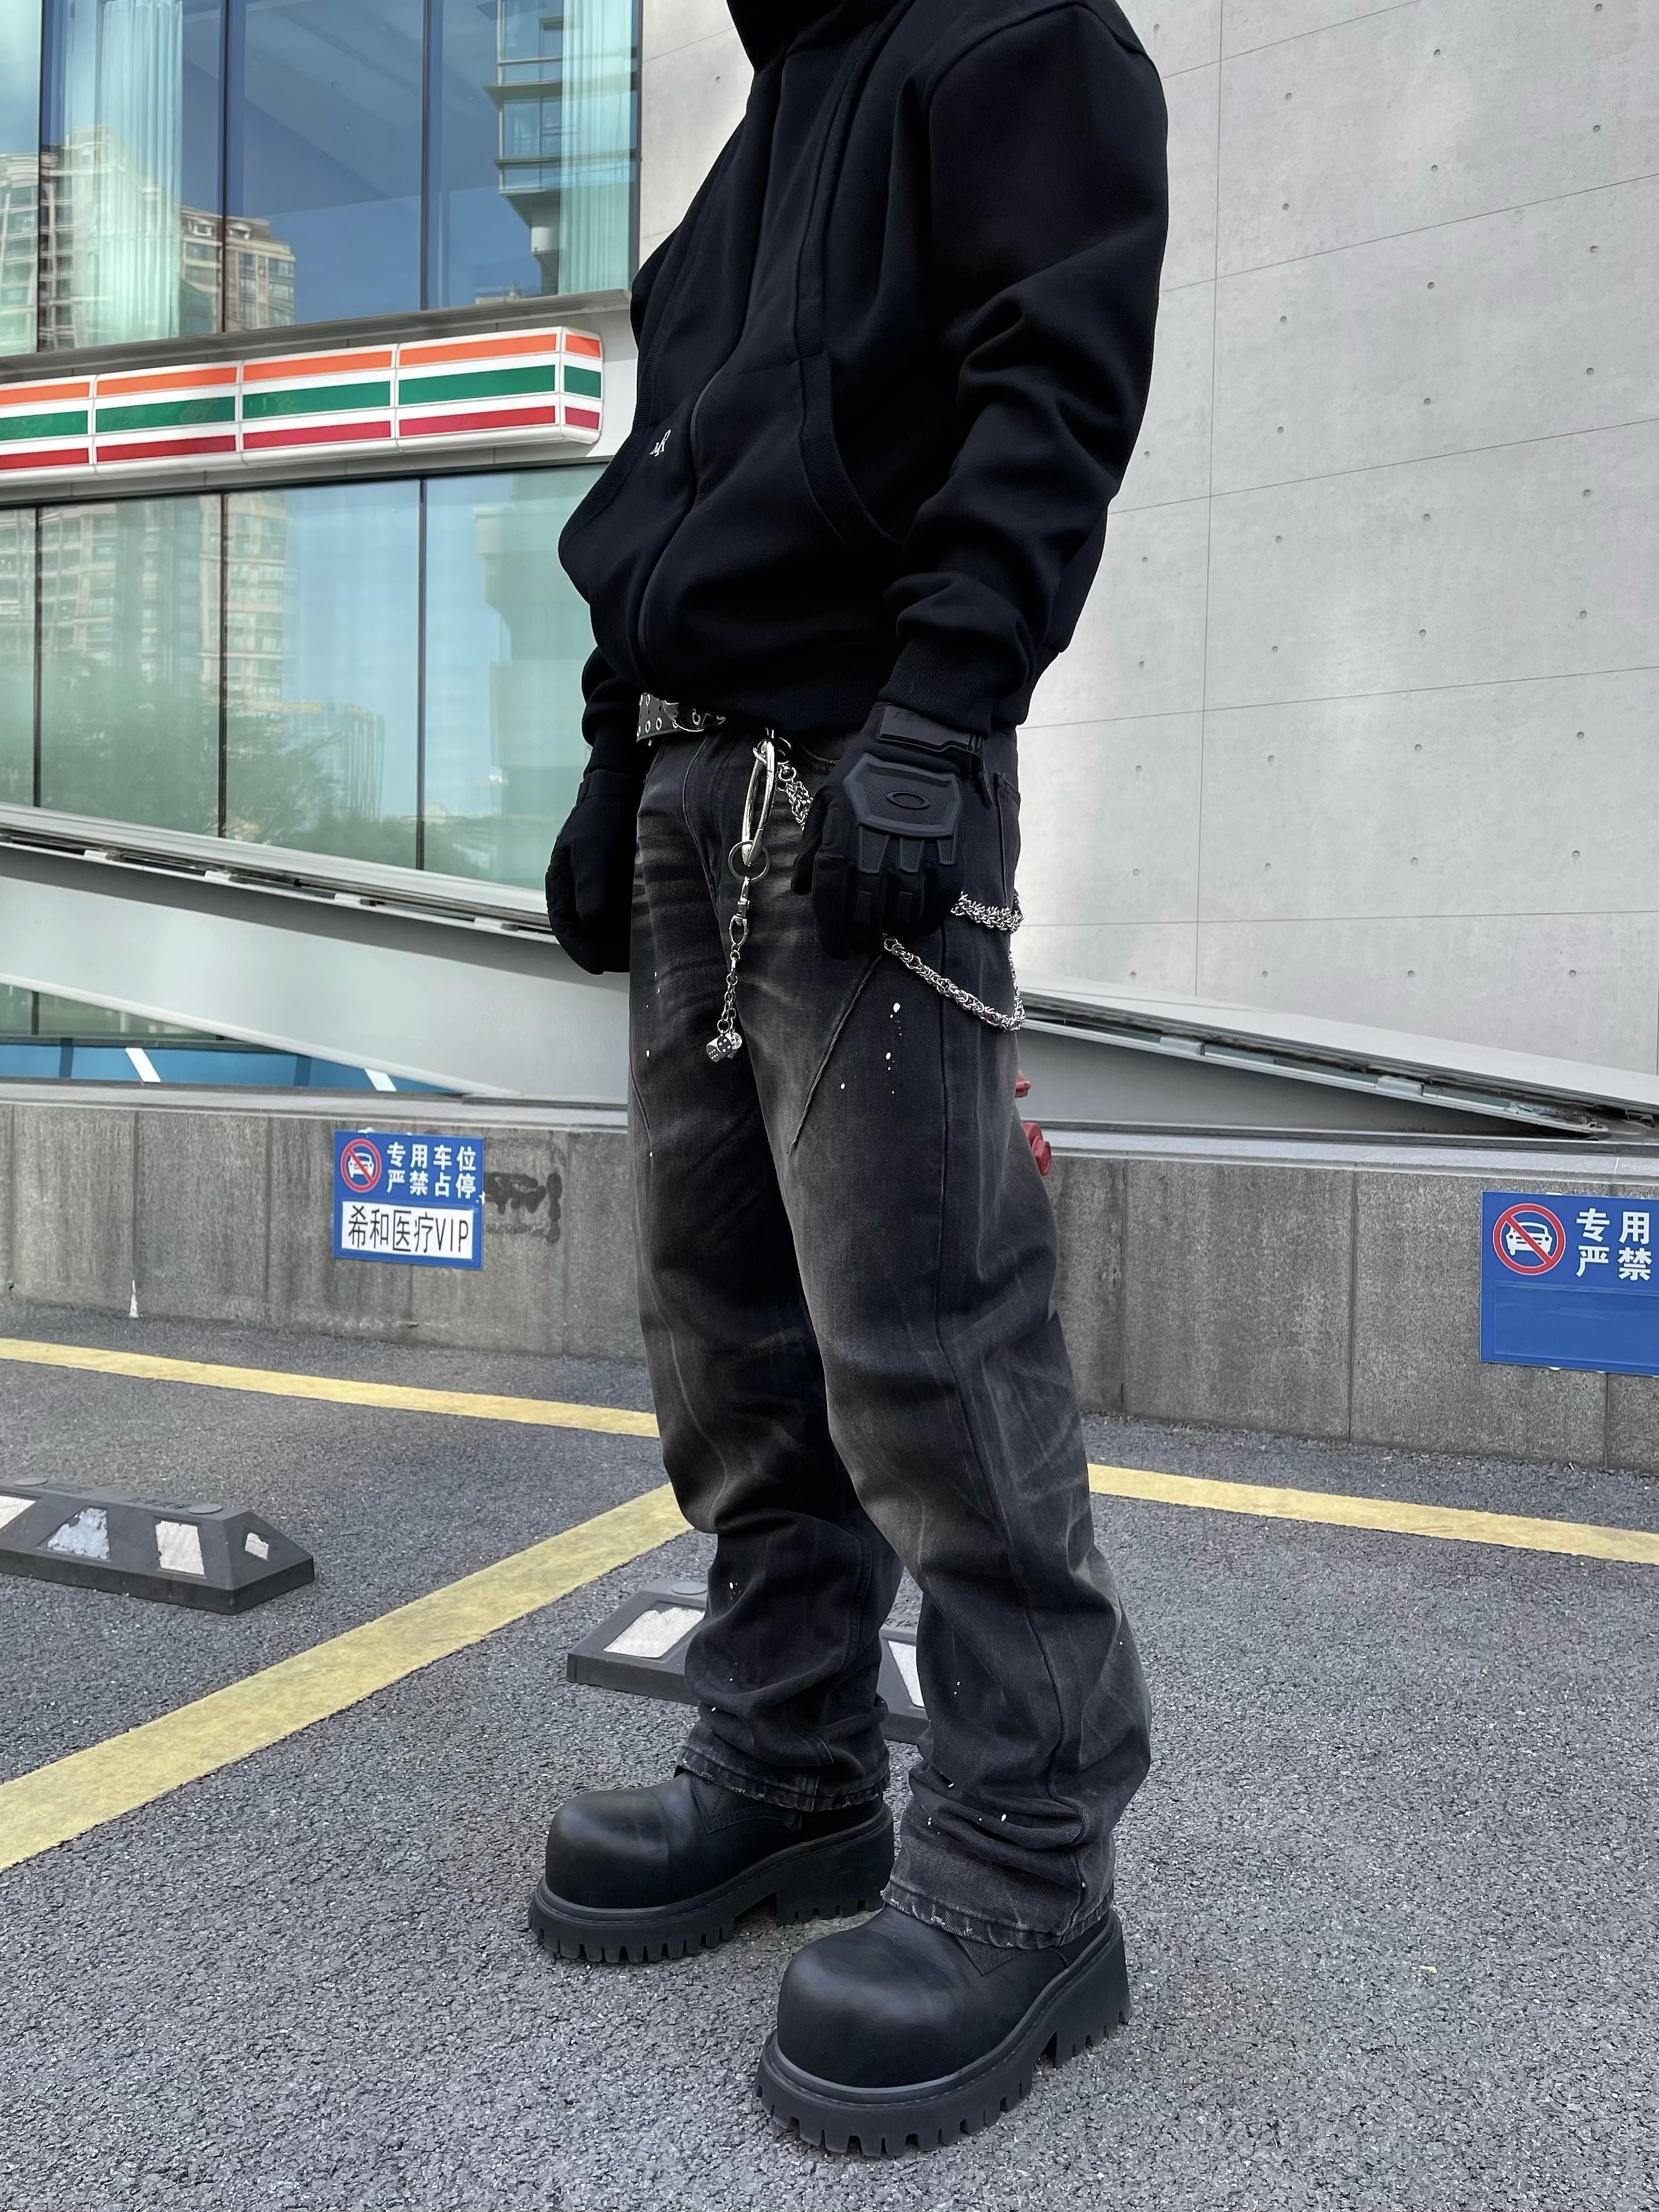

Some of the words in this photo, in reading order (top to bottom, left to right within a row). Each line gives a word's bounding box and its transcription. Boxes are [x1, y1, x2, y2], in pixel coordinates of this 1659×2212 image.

[386, 1141, 476, 1172] 专用车位
[386, 1169, 476, 1199] 严禁占停
[348, 1205, 469, 1253] 希和医疗VIP
[1575, 1207, 1650, 1245] 专用
[1575, 1245, 1653, 1281] 严禁
